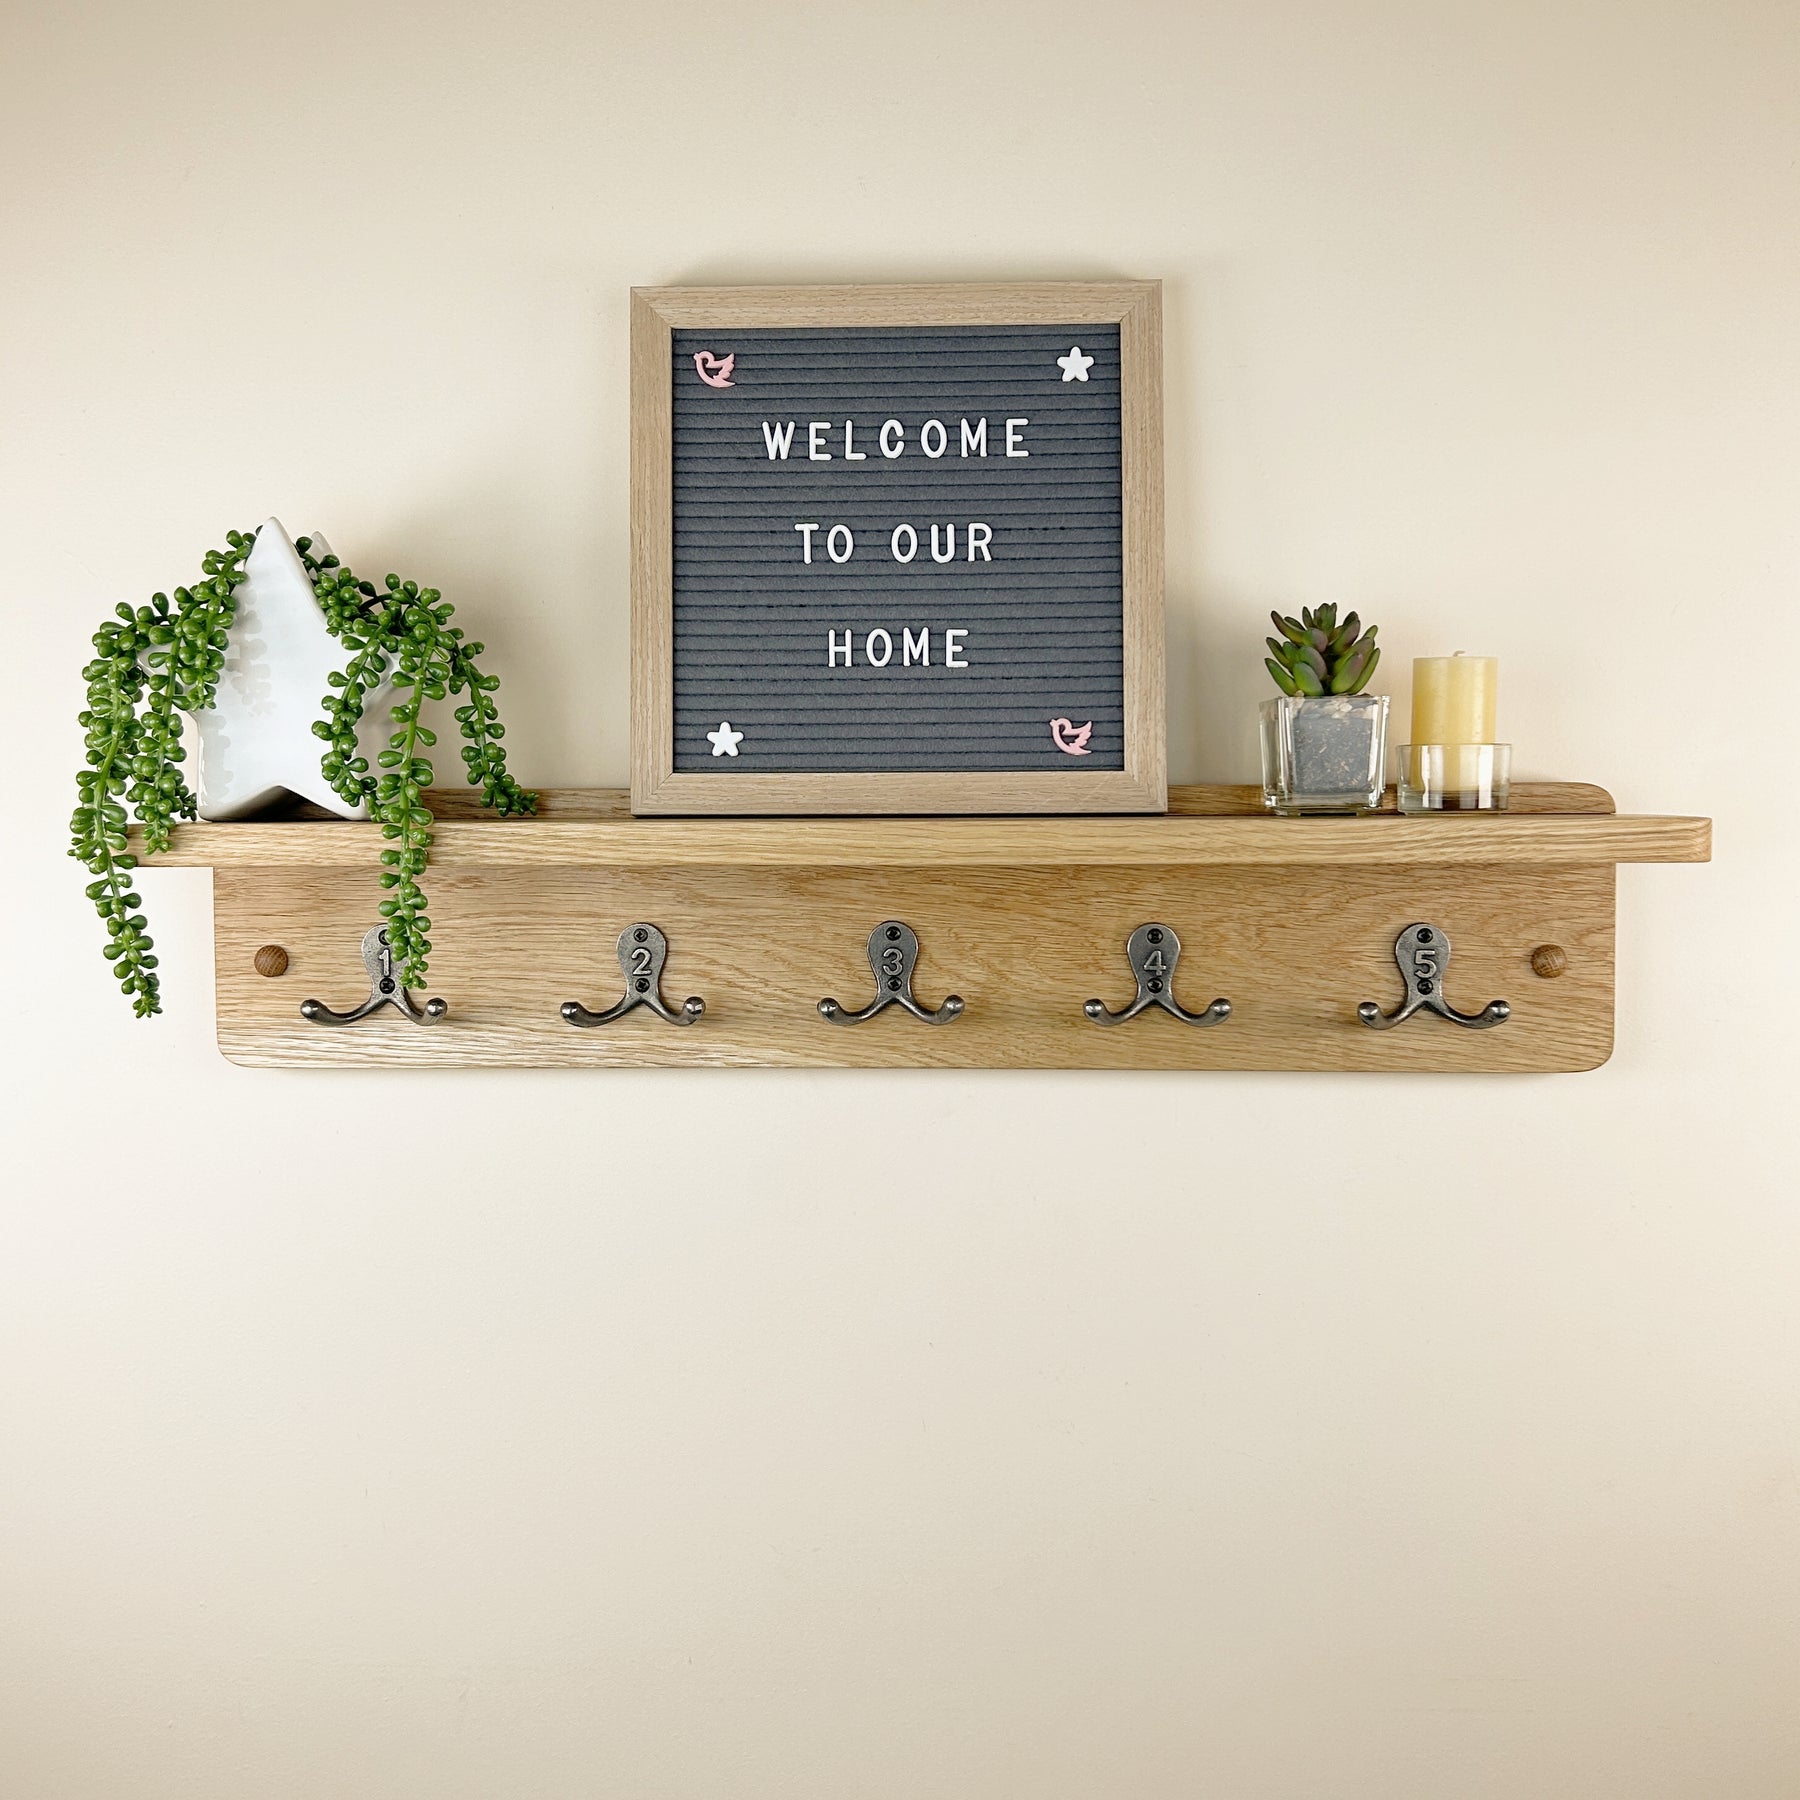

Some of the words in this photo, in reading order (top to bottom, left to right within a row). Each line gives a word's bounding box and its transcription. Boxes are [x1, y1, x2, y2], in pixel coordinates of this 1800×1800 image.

[761, 417, 1030, 461] WELCOME
[794, 523, 854, 565] TO
[891, 522, 993, 564] OUR
[827, 626, 969, 668] HOME
[378, 949, 392, 977] 1
[632, 948, 652, 975] 2
[882, 948, 903, 975] 3
[1143, 949, 1167, 976] 4
[1414, 950, 1437, 979] 5
